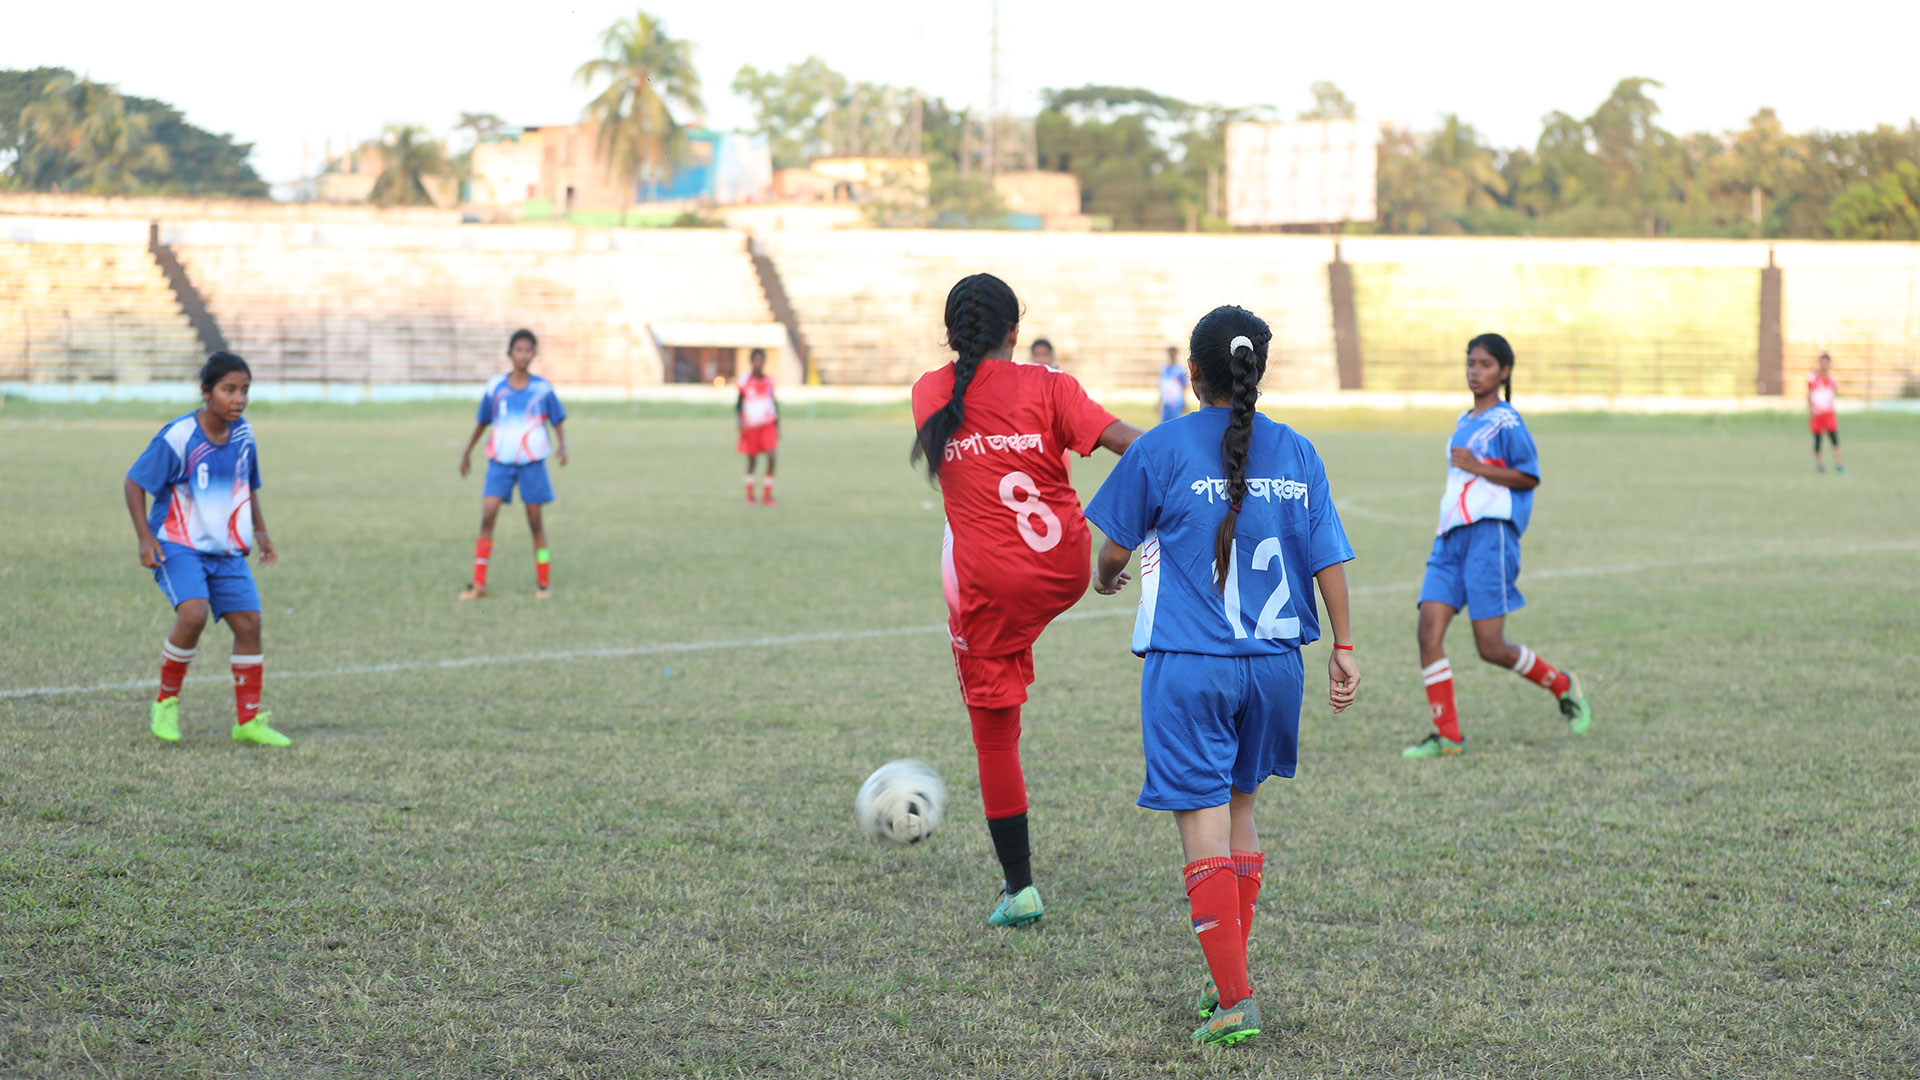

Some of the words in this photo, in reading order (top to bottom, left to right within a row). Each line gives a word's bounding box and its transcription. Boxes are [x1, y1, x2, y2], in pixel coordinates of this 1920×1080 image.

[198, 463, 209, 489] 6
[1246, 475, 1309, 509] অঞ্চল
[999, 471, 1063, 553] 8
[1212, 536, 1300, 640] 12
